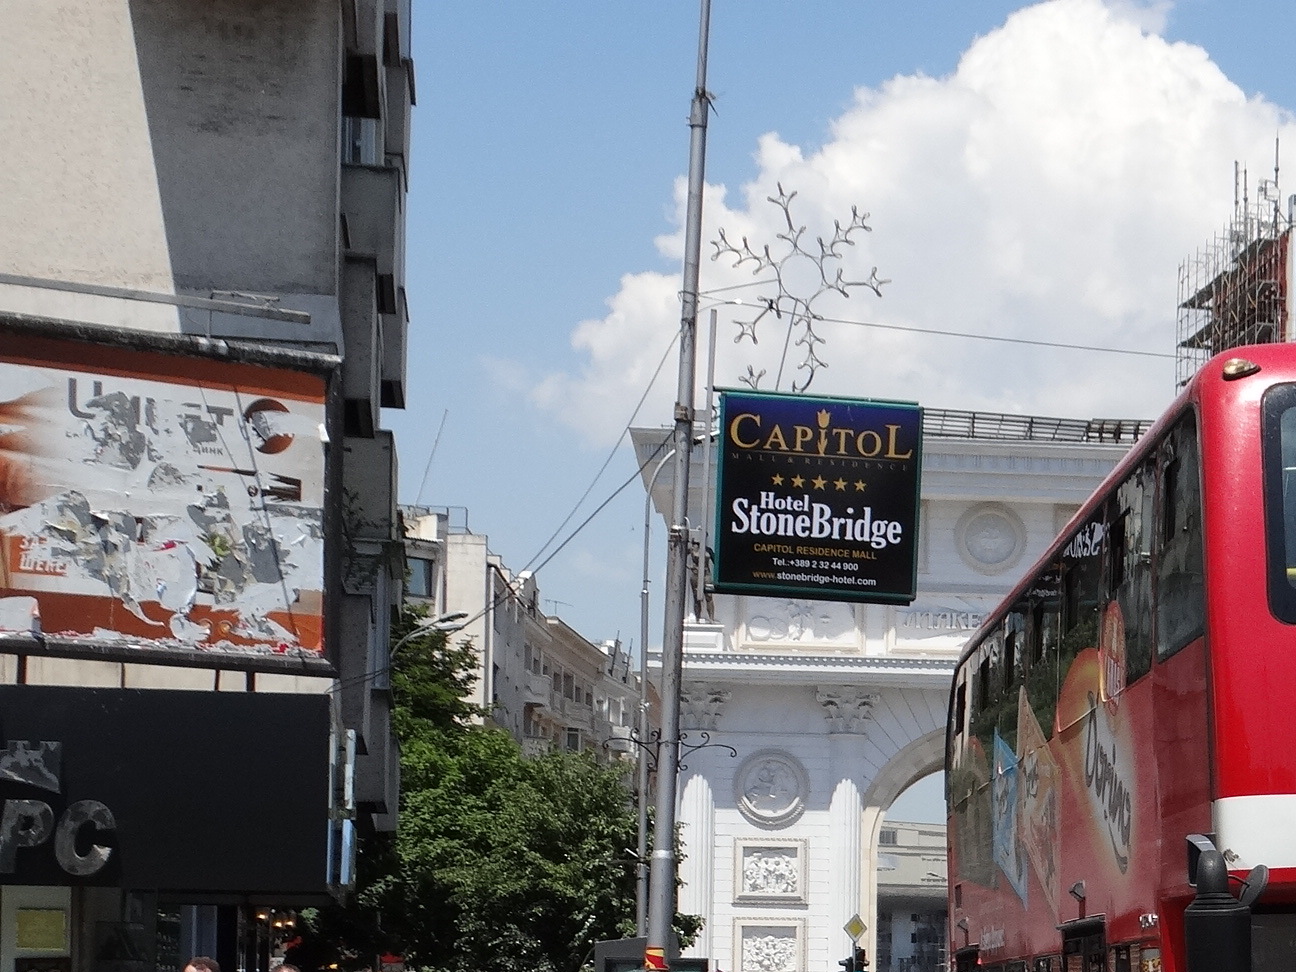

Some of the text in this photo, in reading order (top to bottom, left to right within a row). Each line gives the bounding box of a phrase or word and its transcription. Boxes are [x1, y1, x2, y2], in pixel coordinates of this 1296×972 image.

[730, 409, 913, 460] CAPITOL
[760, 491, 809, 512] Hotel
[731, 498, 902, 549] StoneBridge
[753, 543, 877, 560] CAPITOL RESIDENCE MALL
[812, 560, 818, 568] 2
[819, 561, 829, 569] 32
[831, 562, 841, 570] 44
[843, 563, 859, 571] 900
